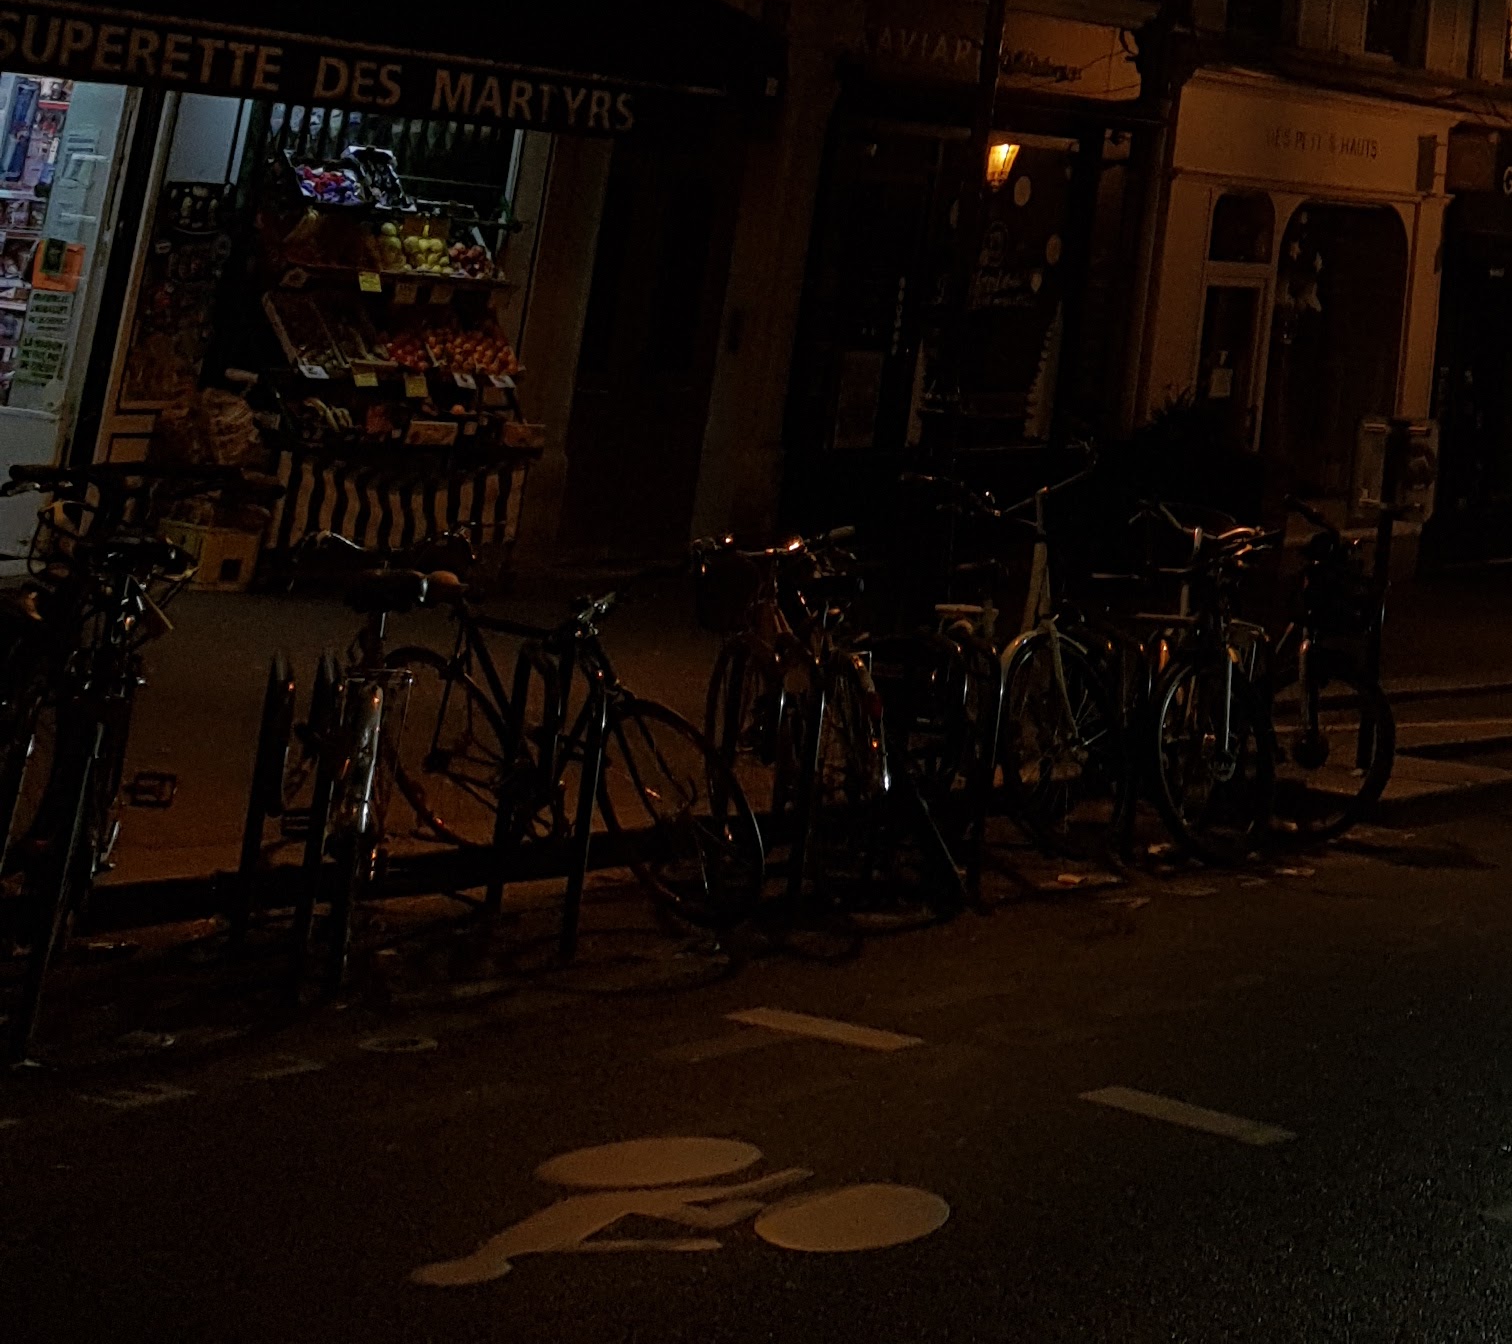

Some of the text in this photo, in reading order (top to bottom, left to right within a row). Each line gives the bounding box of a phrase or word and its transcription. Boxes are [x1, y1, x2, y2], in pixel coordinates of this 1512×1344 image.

[0, 10, 638, 132] SUPERETTE DES MARTYRS
